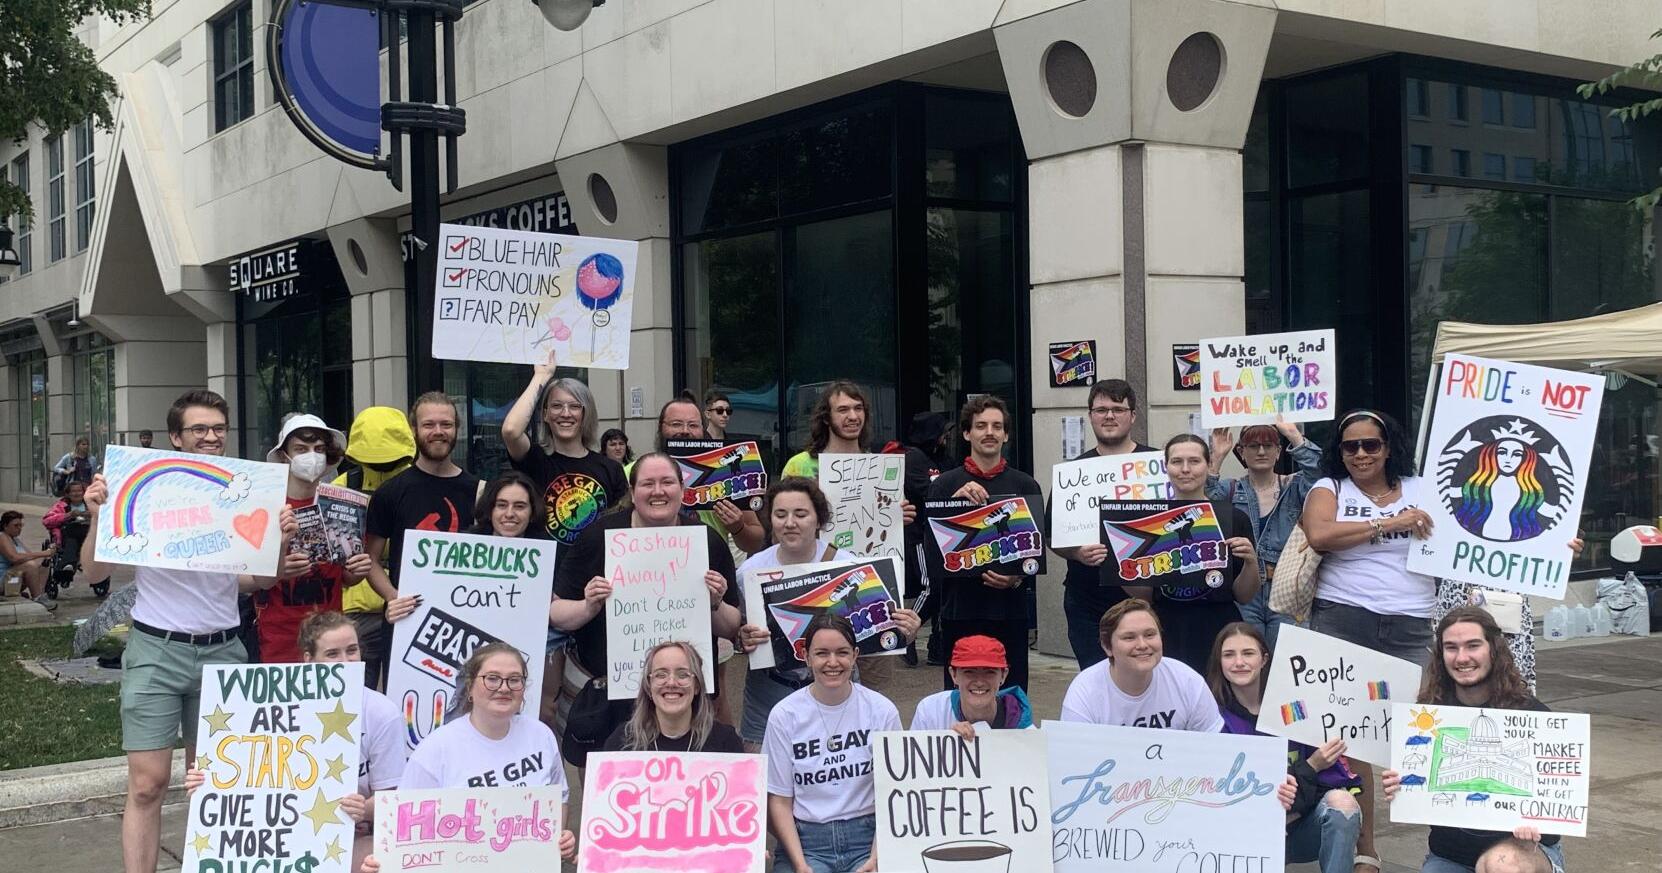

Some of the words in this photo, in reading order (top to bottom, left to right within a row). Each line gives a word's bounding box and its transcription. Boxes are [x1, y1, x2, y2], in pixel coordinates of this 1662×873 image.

[507, 196, 575, 232] COFFE
[468, 237, 519, 264] BLUE
[522, 240, 562, 268] HAIR
[230, 248, 298, 295] SQUARE
[466, 268, 561, 298] PRONOUNS
[255, 283, 277, 302] WINE
[463, 299, 502, 325] FAIR
[508, 301, 540, 328] PAY
[1208, 343, 1256, 358] Wake
[1269, 344, 1288, 360] up
[1298, 337, 1325, 353] and
[1285, 353, 1303, 364] the
[1213, 362, 1320, 393] LABOR
[1446, 360, 1517, 404] PRIDE
[1520, 385, 1531, 396] is
[1541, 379, 1591, 411] NOT
[1210, 391, 1329, 416] VIOLATIONS
[829, 456, 879, 483] SEIZE
[1059, 468, 1090, 489] We
[1096, 472, 1115, 482] are
[1121, 459, 1168, 480] PROU
[552, 477, 571, 494] BE
[574, 476, 604, 497] GAY
[683, 472, 767, 505] STRIKE!
[843, 485, 862, 496] THE
[1066, 493, 1080, 511] of
[1115, 482, 1175, 500] PRID
[1344, 506, 1371, 517] BE
[164, 529, 231, 559] QUEER
[412, 538, 541, 578] STARBUCKS
[611, 532, 690, 568] Sashay
[945, 532, 1041, 571] STRIKE!
[1120, 541, 1227, 580] STRIKE!
[1420, 544, 1434, 556] for
[1452, 540, 1563, 588] PROFIT!!
[610, 561, 678, 596] Away!
[763, 584, 784, 594] UNFAIR
[784, 580, 804, 591] LABOR
[804, 573, 831, 585] PRACTICE
[450, 584, 521, 608] can't
[614, 598, 648, 616] Don't
[417, 614, 490, 665] ERAS
[217, 664, 345, 704] WORKERS
[1290, 655, 1355, 691] People
[250, 705, 300, 733] ARE
[1321, 709, 1392, 743] Profit
[1504, 714, 1538, 729] YOU'LL
[1547, 718, 1568, 729] GET
[1504, 729, 1536, 739] YOUR
[793, 739, 820, 760] BE
[827, 729, 870, 752] GAY
[883, 735, 981, 781] UNION
[1145, 744, 1163, 760] a
[1533, 742, 1584, 758] MARKET
[212, 735, 319, 790] STARS
[468, 770, 499, 788] BE
[503, 752, 543, 781] GAY
[645, 756, 685, 782] on
[823, 754, 846, 766] AND
[1536, 761, 1582, 774] COFFEE
[1537, 789, 1549, 797] WE
[1555, 790, 1574, 799] GET
[200, 793, 254, 827] GIVE
[265, 793, 299, 827] US
[888, 786, 998, 838] COFFEE
[1010, 786, 1038, 834] IS
[1494, 801, 1516, 811] OUR
[1520, 799, 1588, 821] CONTRACT
[397, 799, 485, 842] Hot
[490, 800, 551, 852] girls
[219, 828, 292, 858] MORE
[1052, 827, 1145, 863] BREWED
[402, 851, 444, 868] DON'T
